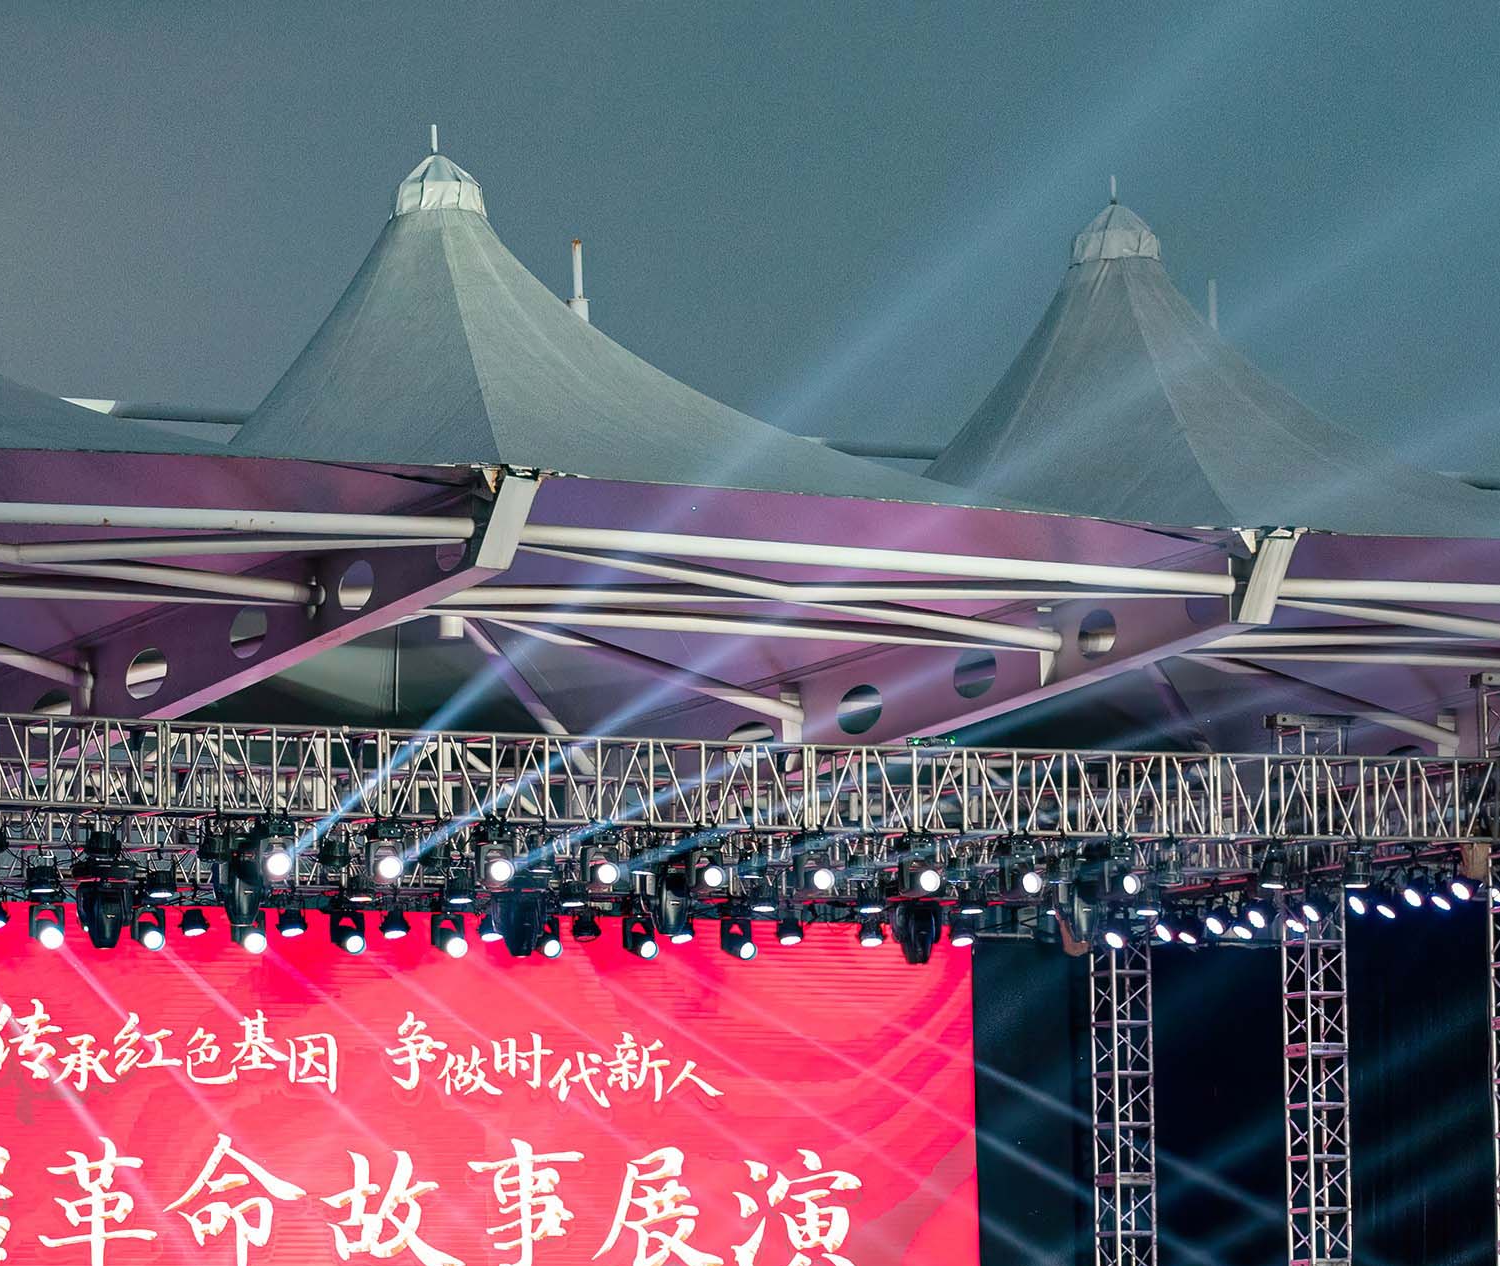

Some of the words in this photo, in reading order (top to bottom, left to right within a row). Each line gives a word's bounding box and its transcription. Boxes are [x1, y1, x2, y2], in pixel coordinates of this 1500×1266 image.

[385, 1011, 724, 1108] 争做时代新人
